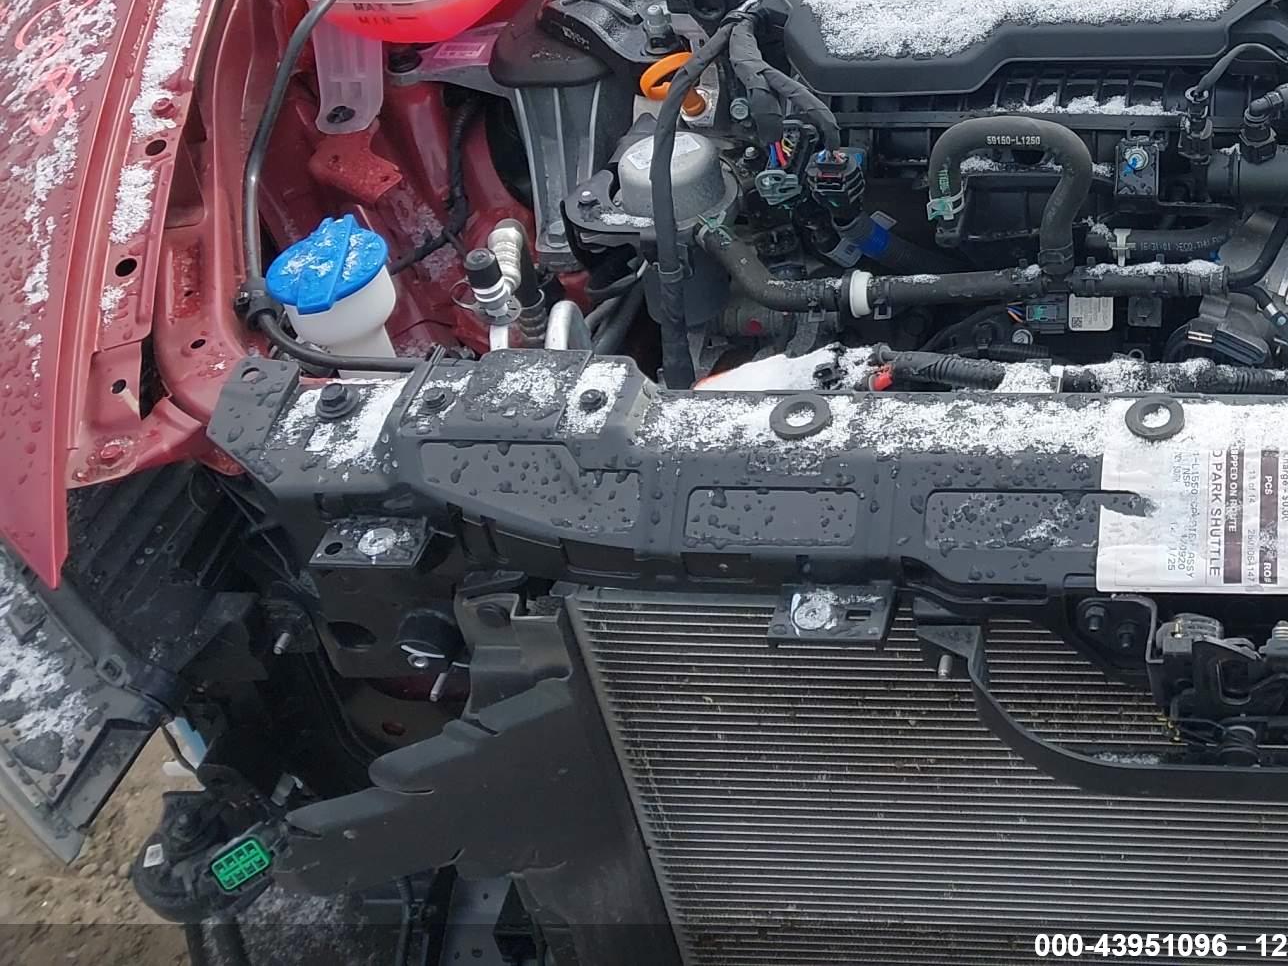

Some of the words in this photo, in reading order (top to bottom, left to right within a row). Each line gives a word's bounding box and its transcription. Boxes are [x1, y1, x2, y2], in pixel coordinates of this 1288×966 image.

[353, 2, 387, 11] MAX
[359, 16, 393, 25] MIN
[1211, 462, 1223, 503] PARK
[1229, 481, 1238, 496] ON
[1264, 475, 1273, 495] PCS
[1209, 508, 1223, 577] SHUTTLE
